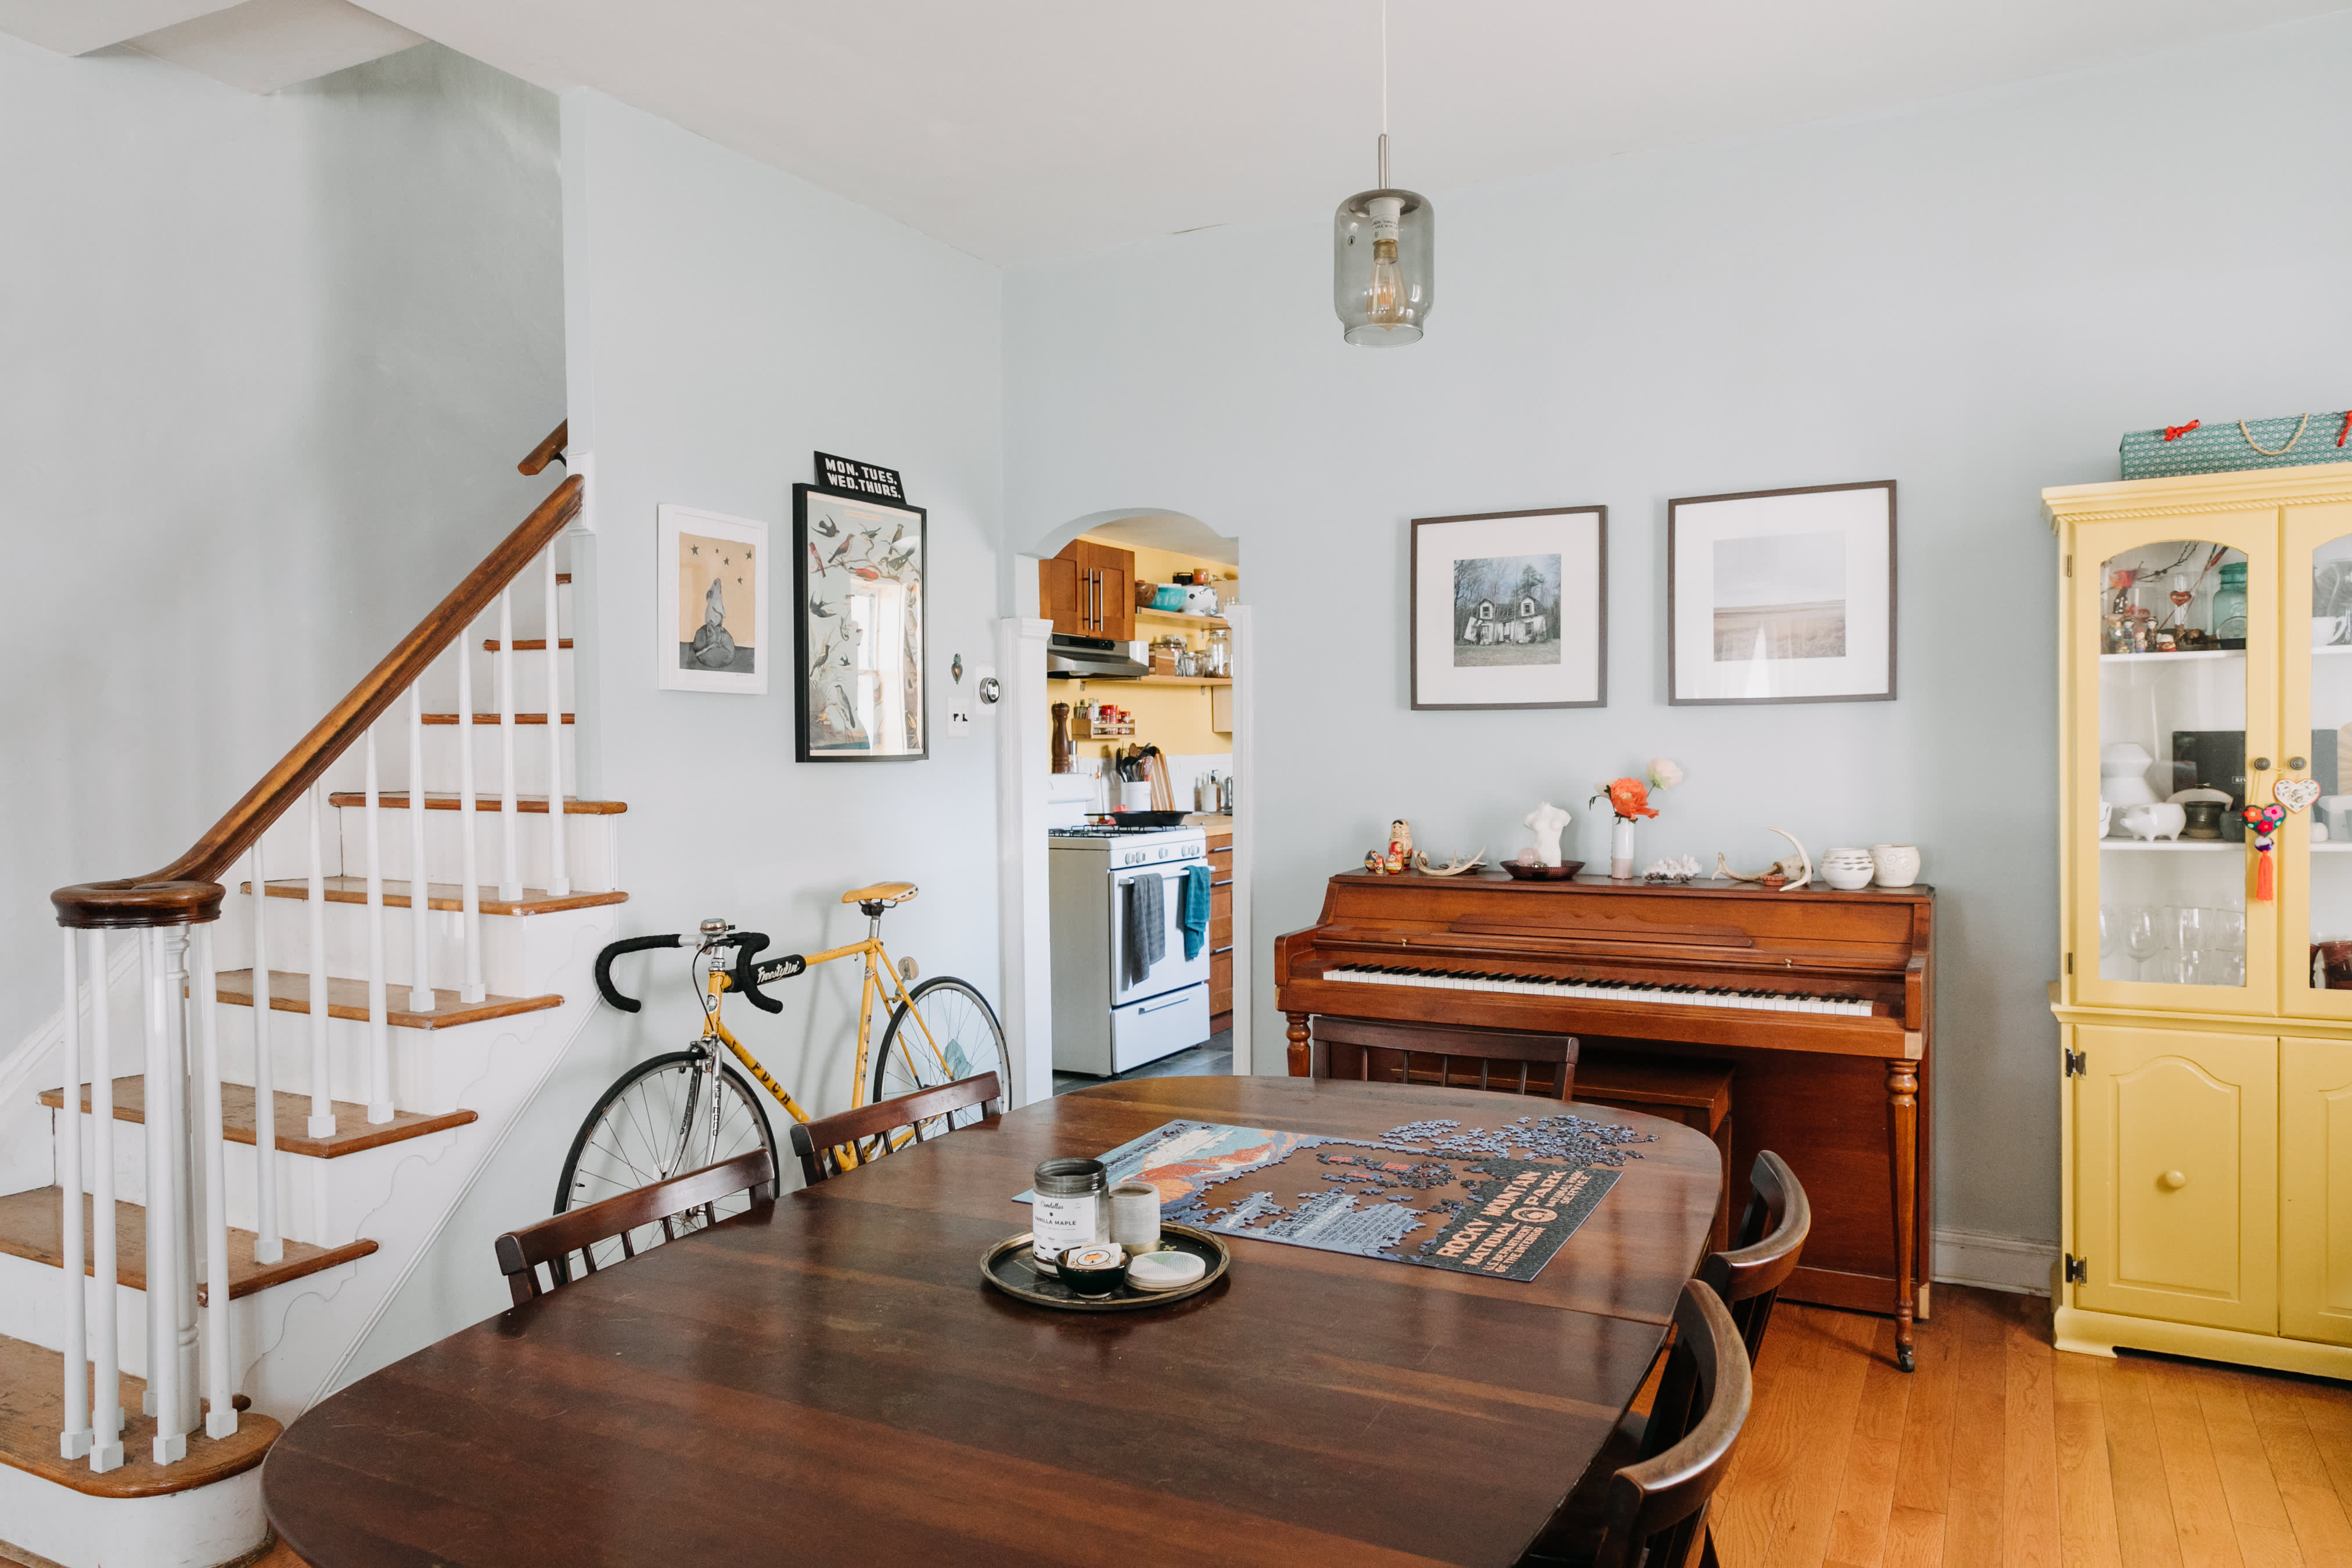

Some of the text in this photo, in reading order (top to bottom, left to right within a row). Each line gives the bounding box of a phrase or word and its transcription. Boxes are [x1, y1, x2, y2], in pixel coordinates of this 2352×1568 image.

[825, 458, 897, 485] MON. TUES.
[826, 472, 901, 498] WED. THURS.
[757, 961, 800, 984] Freestylin'
[1545, 1170, 1585, 1207] NATIONAL PARK
[1560, 1175, 1591, 1204] SERVICE
[1435, 1218, 1493, 1258] ROCKY
[1480, 1170, 1542, 1217] MOUNTAIN
[1462, 1170, 1567, 1266] NATIONAL PARK
[1495, 1227, 1547, 1273] OF THE INTERIOR
